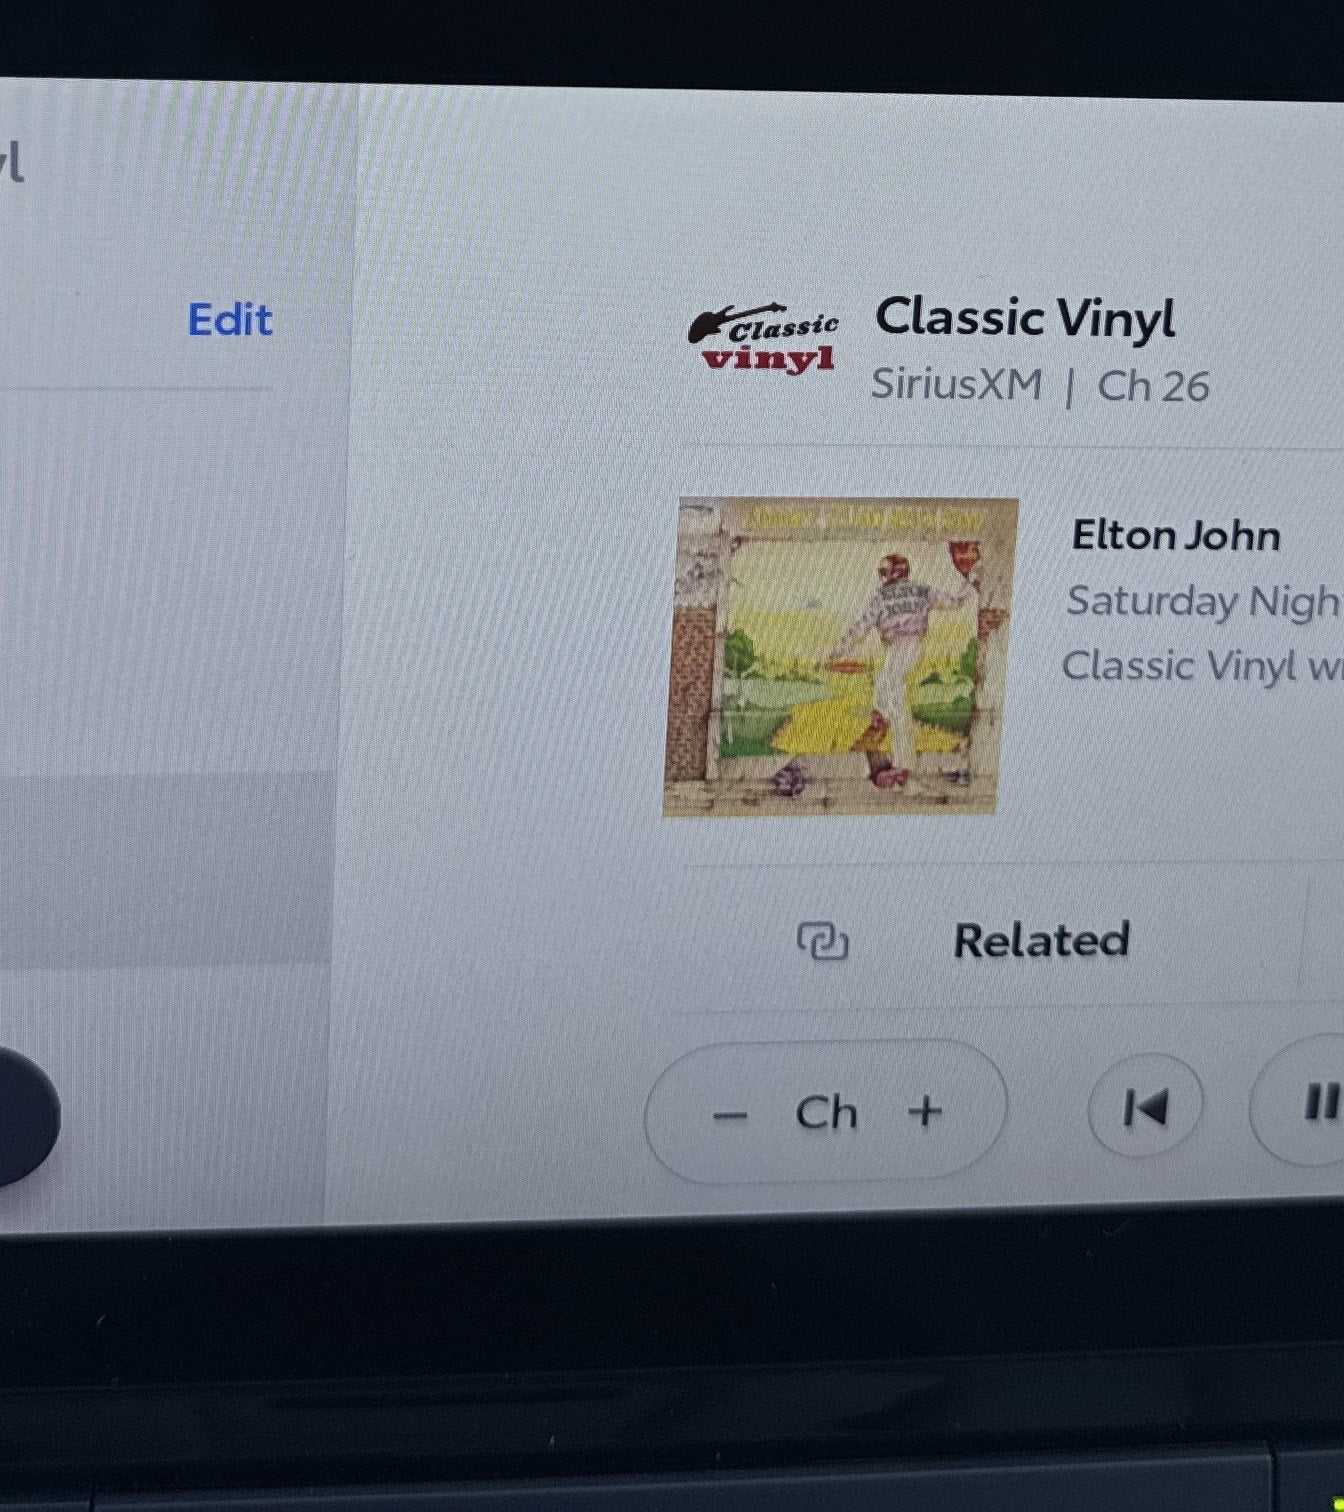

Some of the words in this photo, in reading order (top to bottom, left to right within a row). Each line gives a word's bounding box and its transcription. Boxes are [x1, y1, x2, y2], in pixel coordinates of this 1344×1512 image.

[189, 301, 274, 336] Edit
[729, 314, 839, 342] Classic
[876, 294, 1045, 336] Classic
[1056, 296, 1176, 349] Vinyl
[701, 345, 835, 376] vinyl
[871, 366, 1042, 401] SiriusXM
[1098, 368, 1151, 402] Ch
[1162, 370, 1210, 403] 26
[1073, 517, 1177, 551] Elton
[1184, 518, 1281, 551] John
[1067, 583, 1240, 626] Saturday
[1062, 648, 1195, 682] Classic
[1207, 648, 1297, 690] Vinyl
[954, 919, 1131, 959] Related
[796, 1093, 858, 1131] Ch
